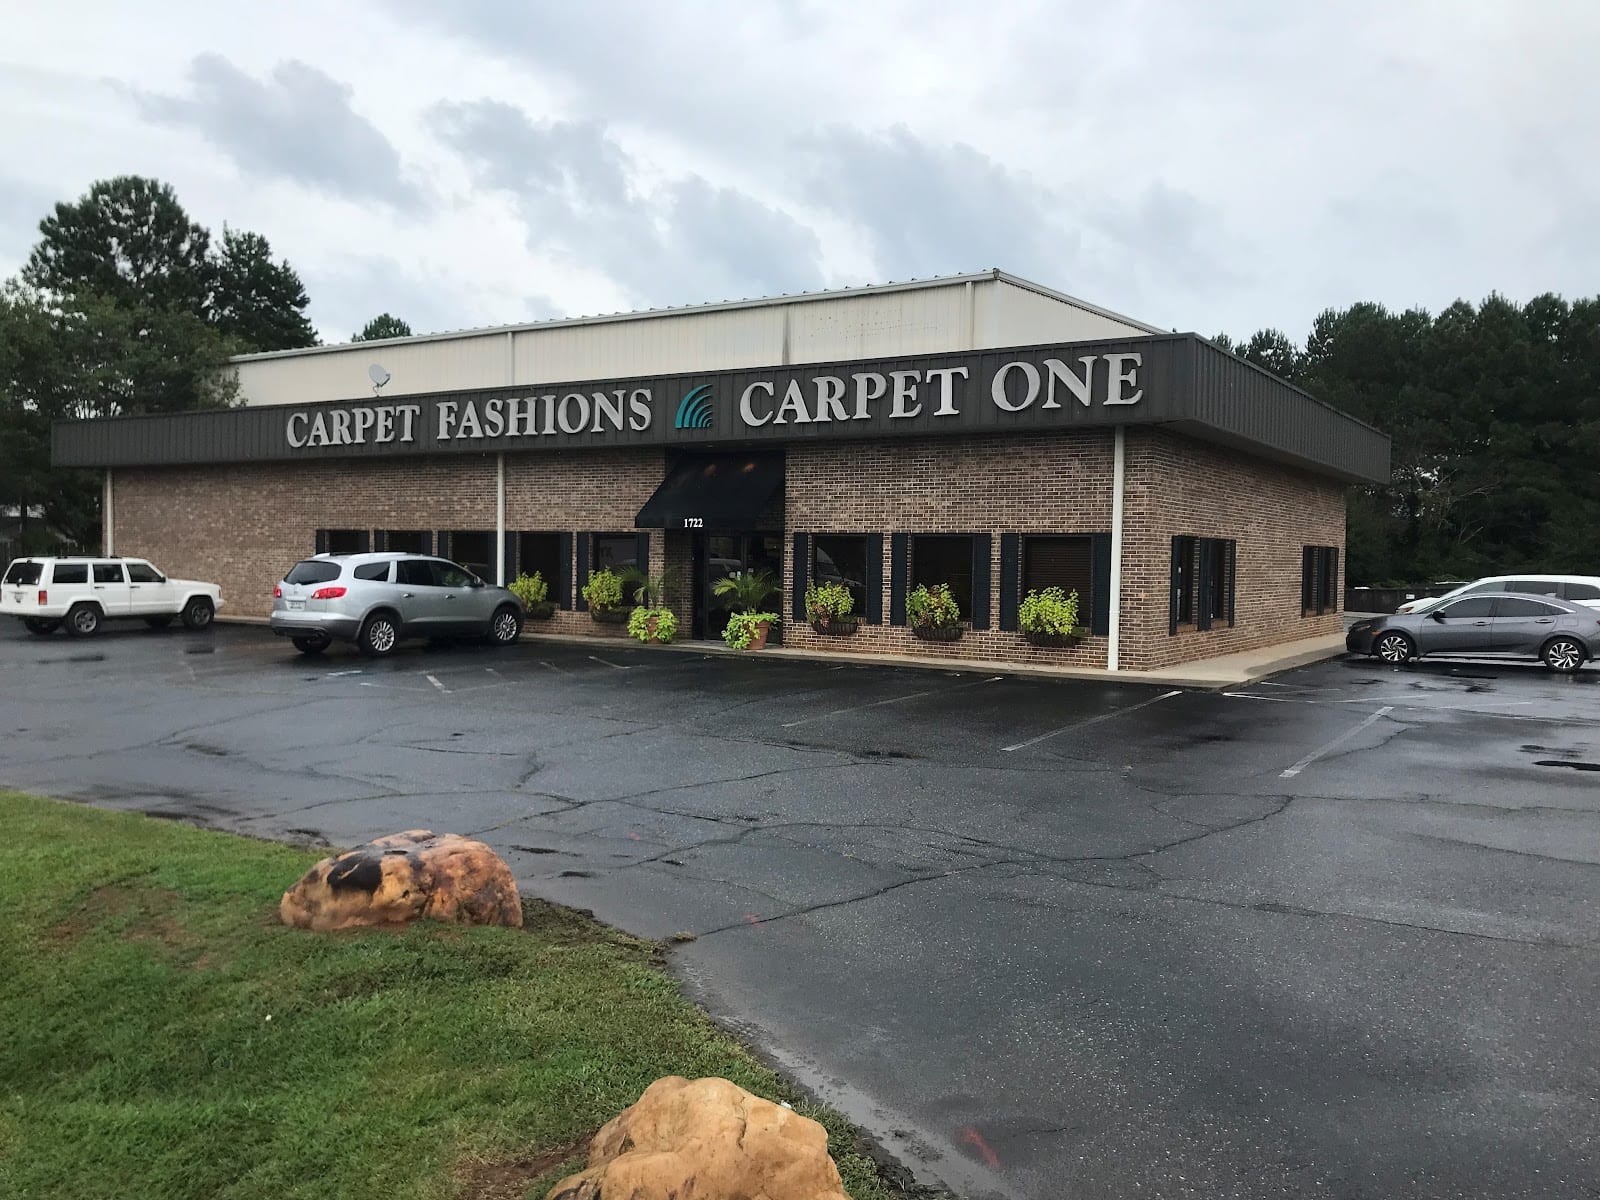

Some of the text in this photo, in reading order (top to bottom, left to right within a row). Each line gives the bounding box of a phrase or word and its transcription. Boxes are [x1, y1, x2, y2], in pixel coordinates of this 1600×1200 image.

[286, 388, 653, 448] CARPET FASHIONS
[739, 352, 1143, 427] CARPET ONE
[683, 518, 703, 528] 1722
